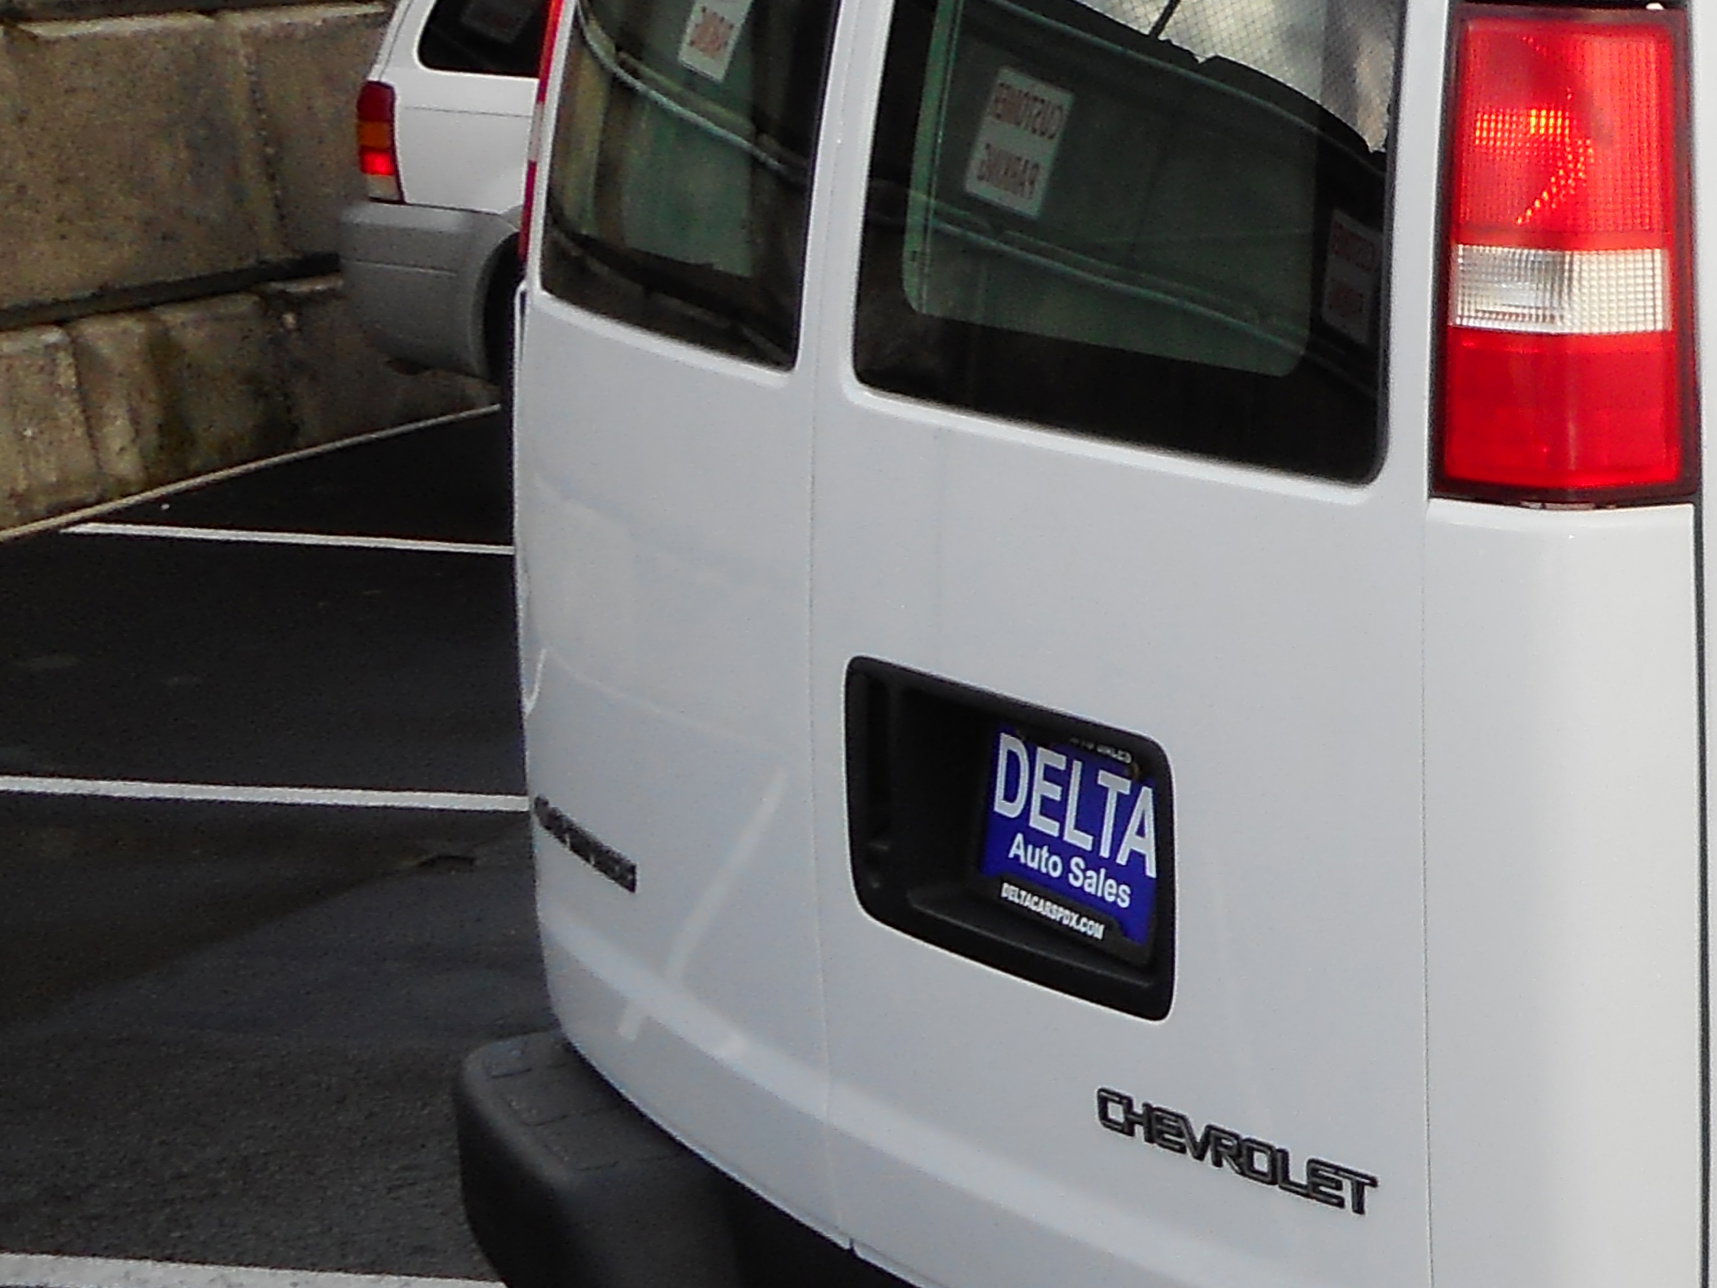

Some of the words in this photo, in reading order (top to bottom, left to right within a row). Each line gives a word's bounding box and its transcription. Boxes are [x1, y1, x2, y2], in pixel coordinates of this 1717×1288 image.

[993, 732, 1157, 879] DELTA
[1001, 882, 1106, 941] DELTACARSPDX.COM
[1008, 832, 1063, 879] Auto
[1068, 856, 1132, 909] Sales
[1097, 1086, 1379, 1216] CHEVROLET
